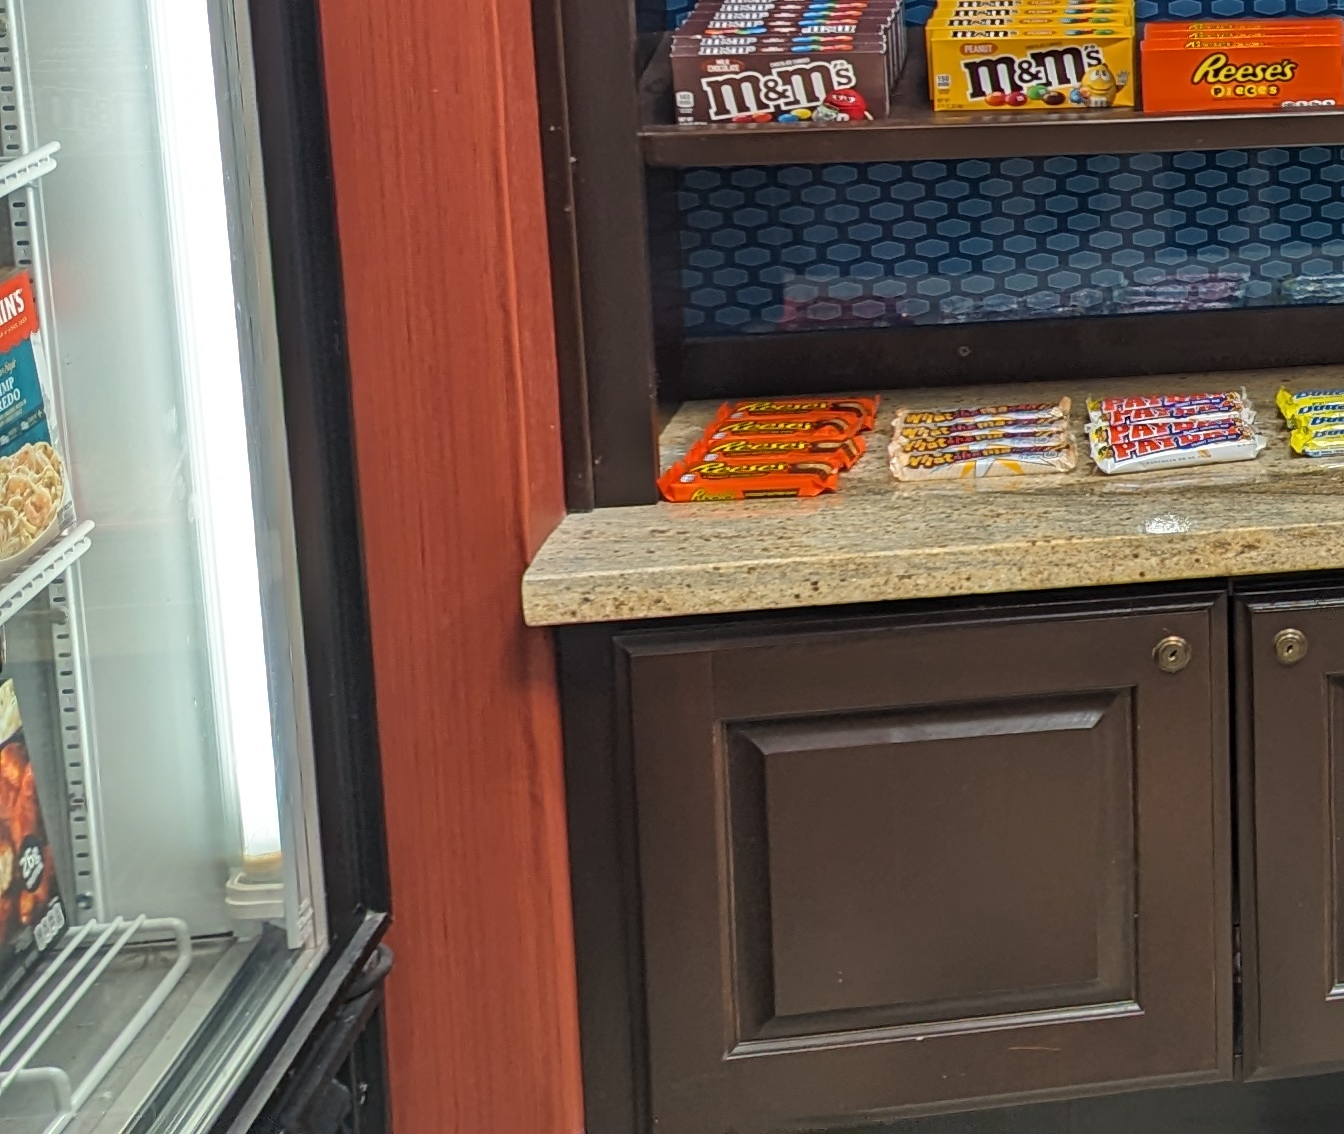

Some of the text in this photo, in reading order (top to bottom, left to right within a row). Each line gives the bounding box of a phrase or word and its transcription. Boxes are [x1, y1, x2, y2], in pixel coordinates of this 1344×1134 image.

[702, 61, 856, 119] m&m's
[962, 45, 1103, 99] m&m's
[1193, 52, 1298, 85] Reese's
